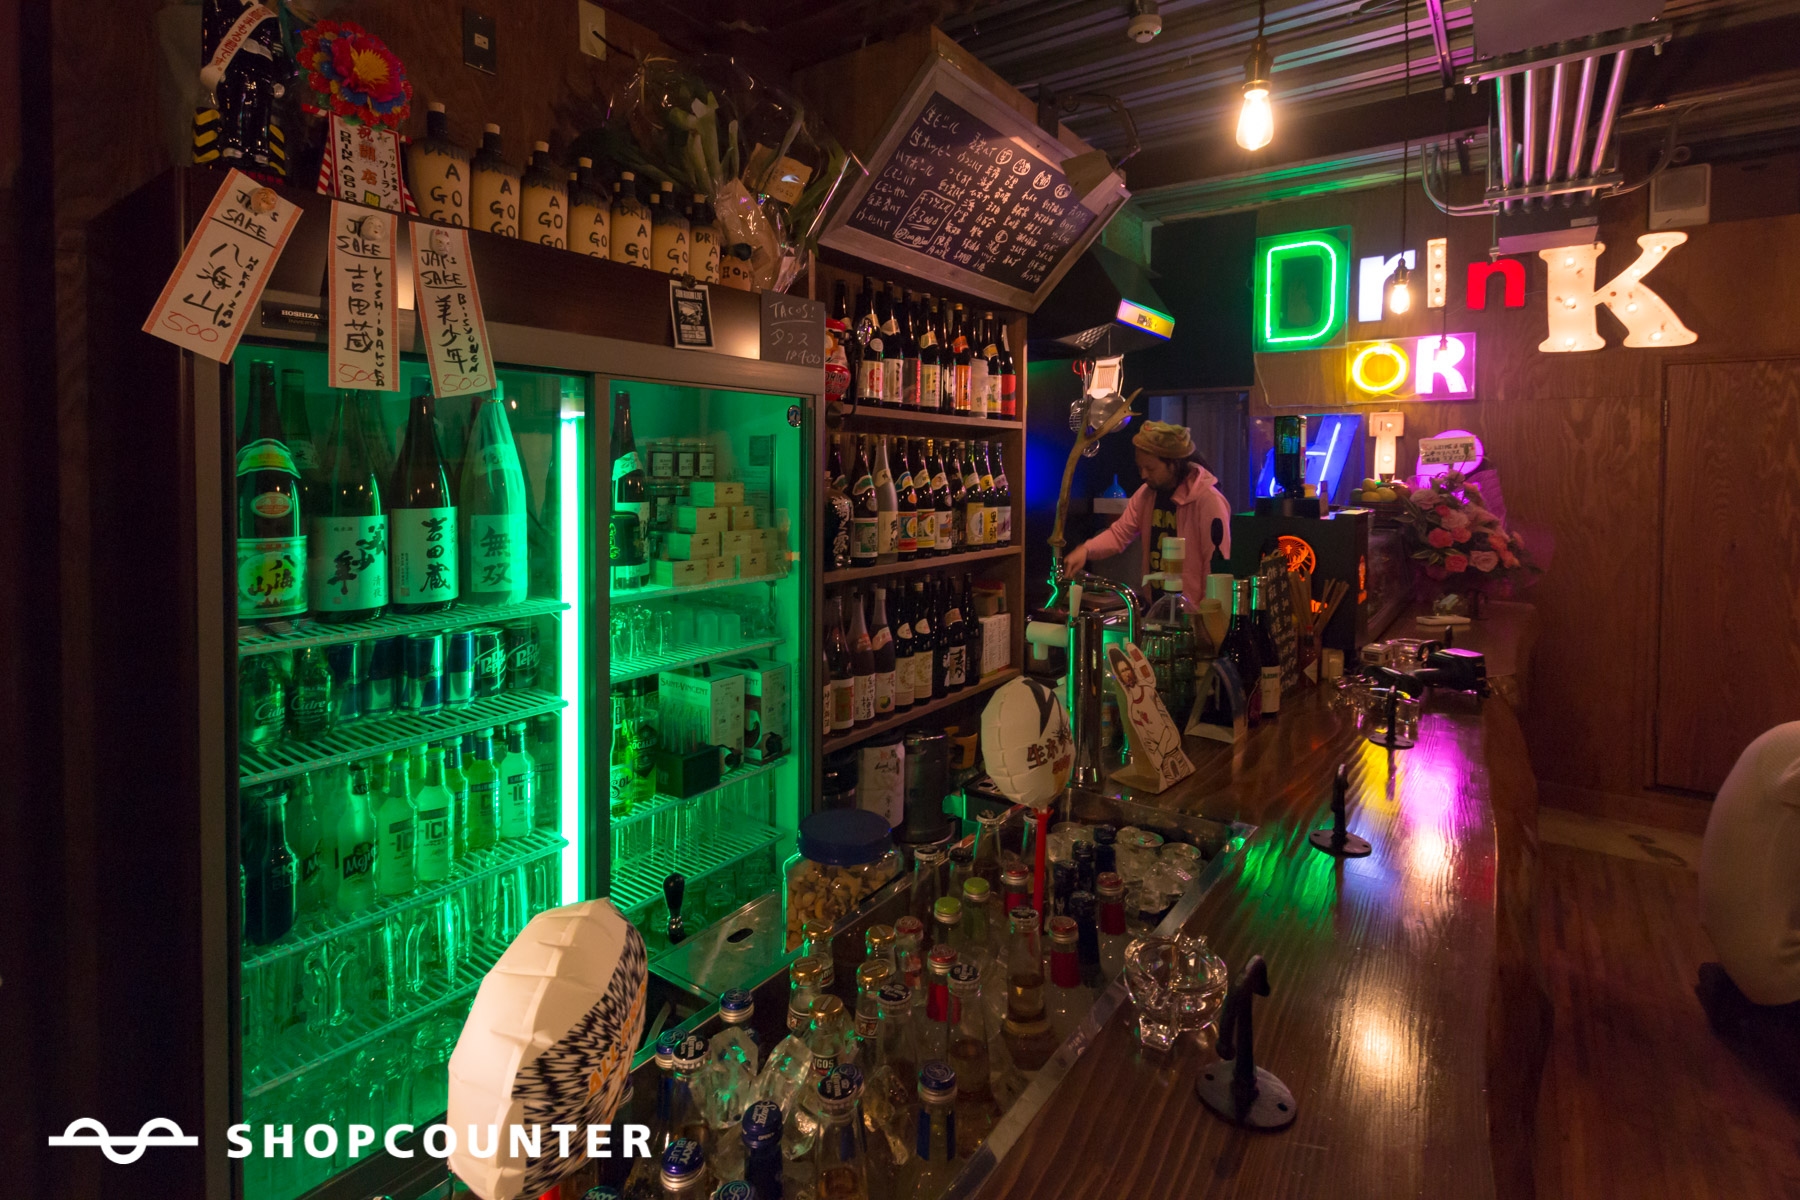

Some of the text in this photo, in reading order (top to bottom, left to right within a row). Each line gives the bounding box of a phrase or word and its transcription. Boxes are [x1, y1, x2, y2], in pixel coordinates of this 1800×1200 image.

[445, 163, 461, 182] A
[500, 178, 513, 196] A
[430, 186, 463, 207] GO
[549, 195, 561, 210] A
[490, 200, 516, 221] GO
[593, 213, 605, 226] A
[221, 208, 267, 240] SAKE
[538, 211, 563, 230] GO
[588, 231, 608, 247] GO
[637, 224, 648, 238] A
[676, 232, 686, 245] A
[336, 235, 382, 257] SAKE
[624, 243, 650, 260] GO
[709, 246, 719, 257] A
[182, 242, 244, 325] 八海山
[420, 270, 464, 287] SAKE
[281, 310, 321, 320] HOSHIZA
[161, 310, 220, 343] 500
[440, 374, 489, 392] 500
[420, 516, 451, 593] 吉田蔵
[480, 525, 513, 585] 無双
